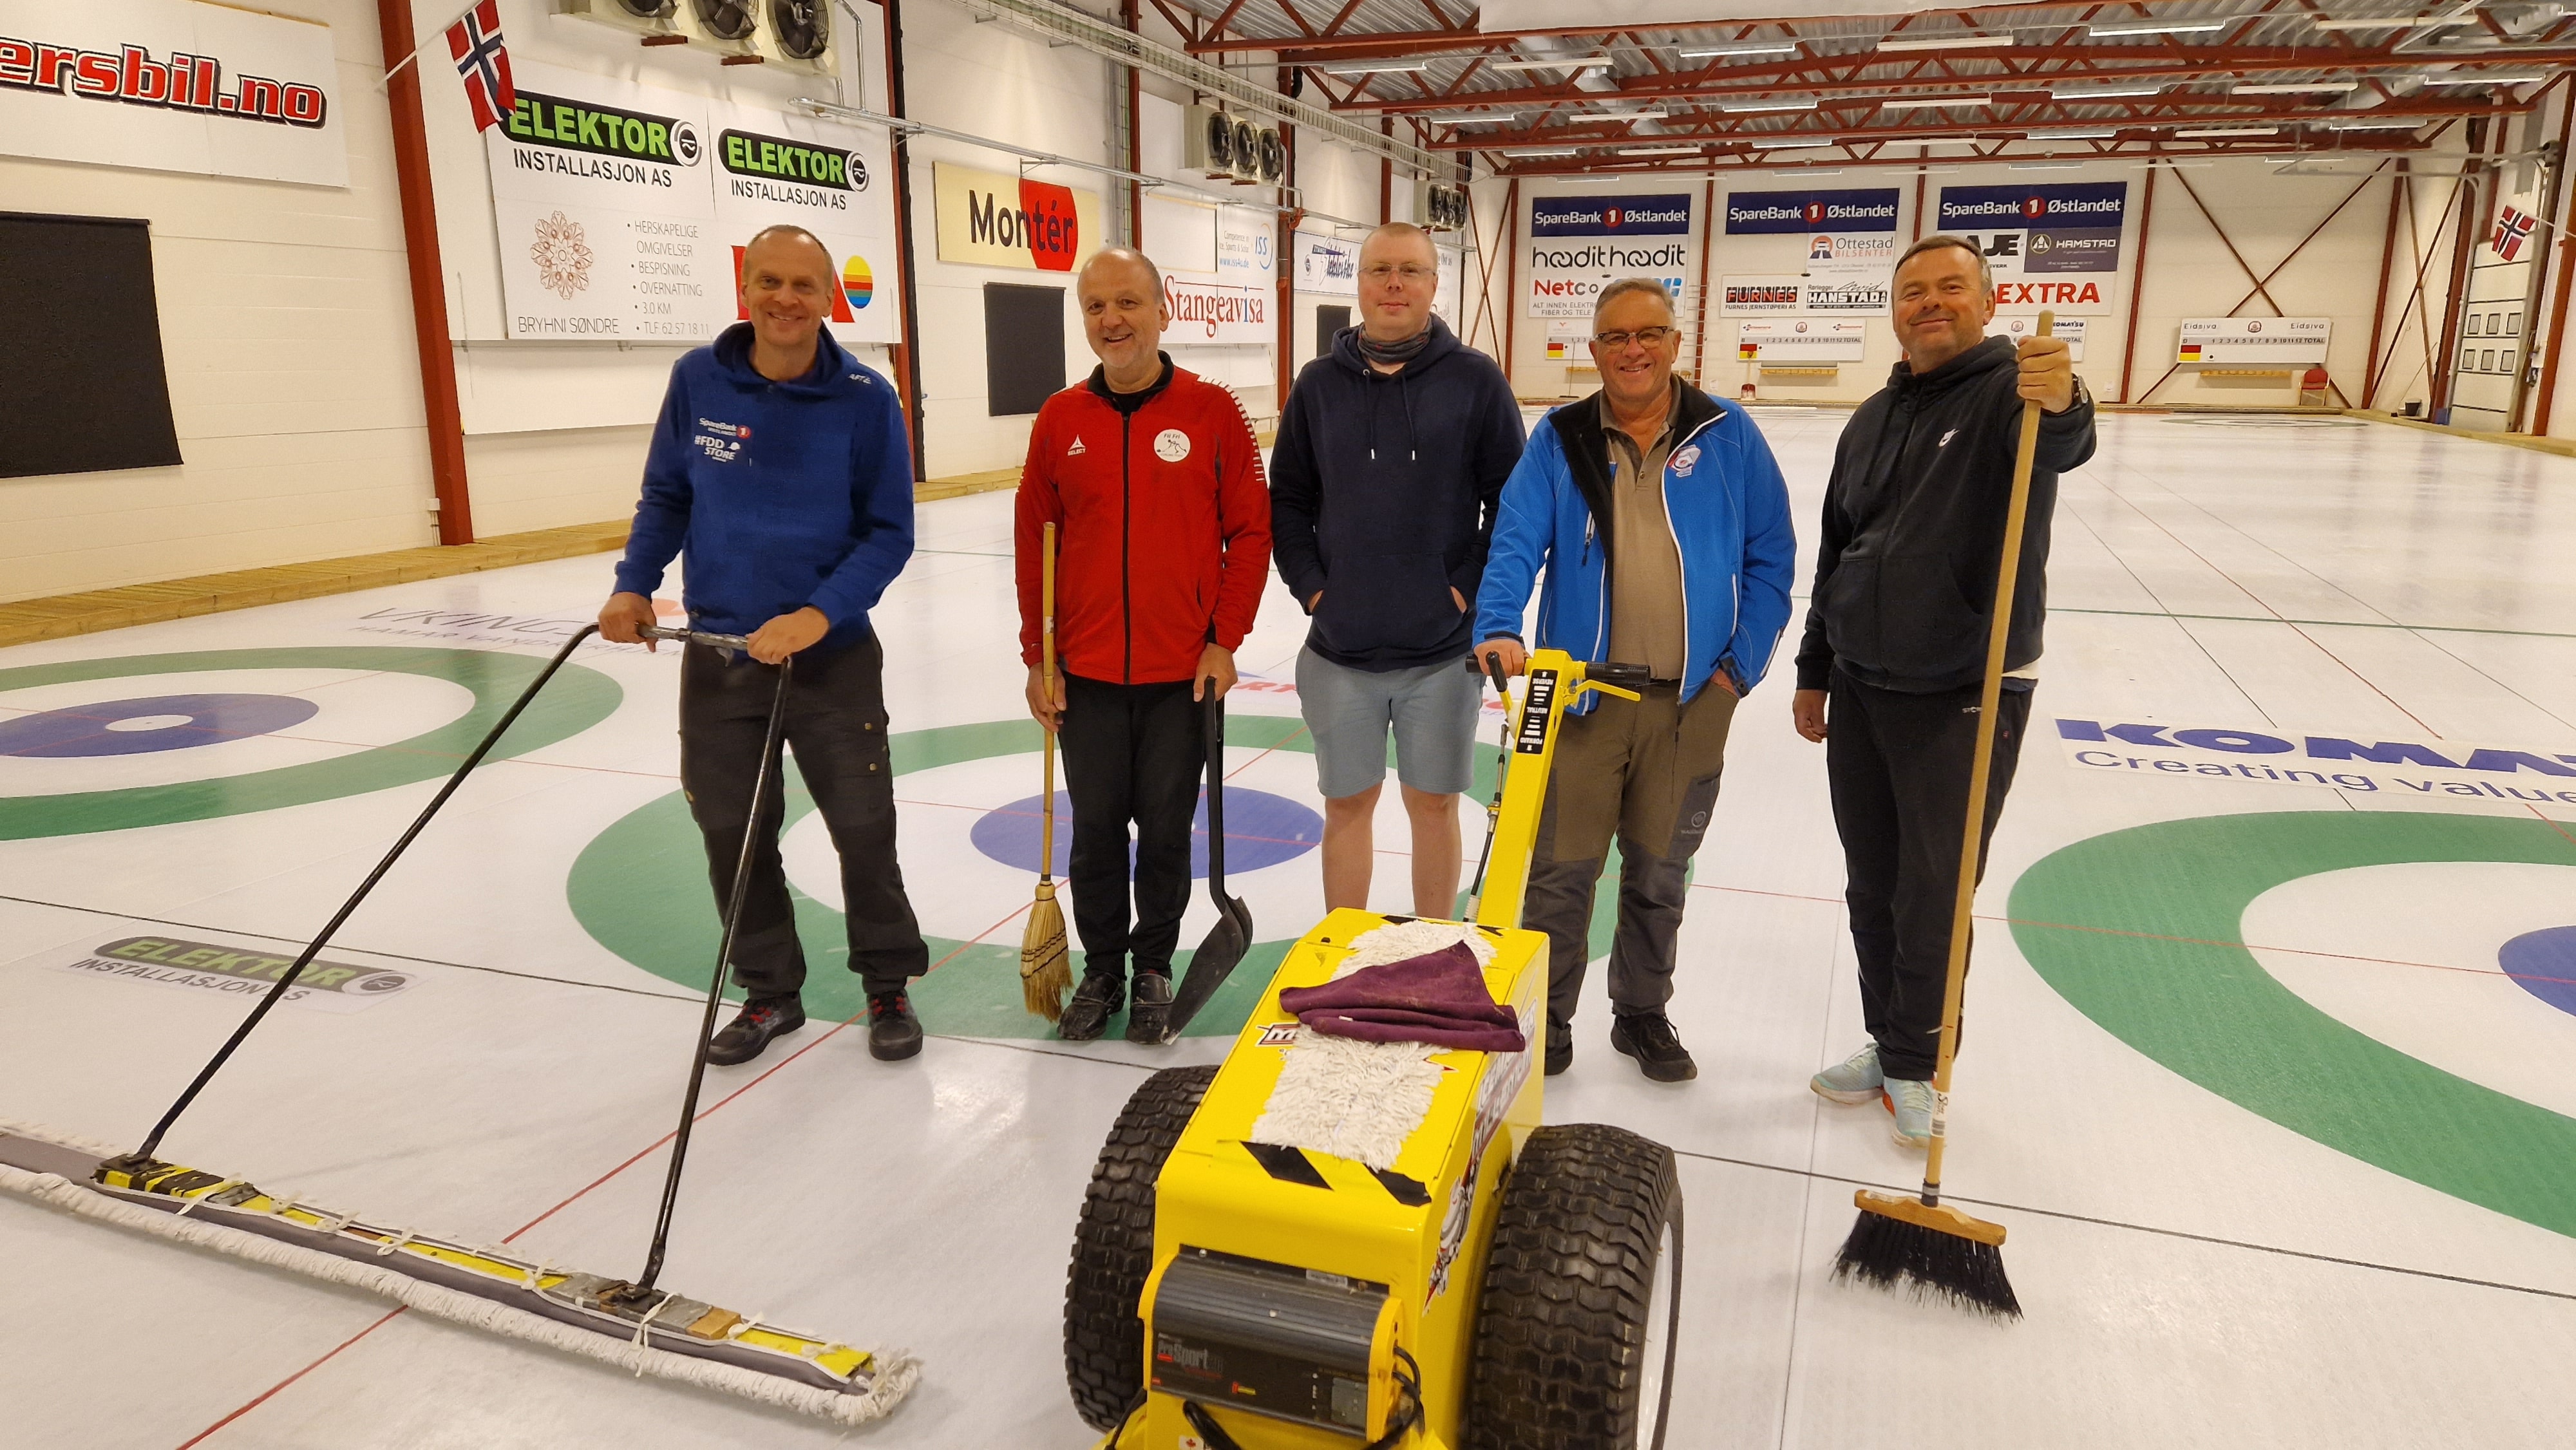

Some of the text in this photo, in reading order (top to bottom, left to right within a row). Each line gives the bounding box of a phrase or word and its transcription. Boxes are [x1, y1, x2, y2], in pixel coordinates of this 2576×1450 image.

[0, 37, 327, 129] ersbil.no
[509, 98, 670, 157] ELEKTOR
[513, 148, 672, 187] INSTALLASJON AS
[727, 136, 845, 184] ELEKTOR
[731, 179, 846, 210] INSTALLASJON AS
[1730, 204, 1895, 223] SpareBank 1 Østlandet
[1942, 198, 2121, 218] SpareBank 1 Østlandet
[969, 190, 1073, 253] Montér
[1535, 209, 1687, 226] SpareBank 1 Østlandet
[635, 221, 699, 238] HERSKAPELIGE
[636, 240, 692, 256] OMGIVELSER
[1836, 237, 1893, 249] Ottestad
[2056, 239, 2116, 249] HAMSTAD
[639, 261, 690, 276] BESPISNING
[640, 281, 702, 296] OVERNATTING
[1726, 287, 1797, 303] FURNES
[1808, 292, 1879, 303] HANSTAD
[1996, 282, 2101, 304] EXTRA
[658, 303, 671, 314] KM
[1164, 275, 1264, 337] Stangeavisa
[518, 317, 620, 334] BRYHNI SØNDRE
[644, 321, 659, 334] TLF
[662, 322, 672, 334] 62
[676, 323, 685, 334] 57
[699, 418, 737, 431] SpareBank
[704, 447, 735, 460] STORE
[359, 608, 589, 636] VIKING
[2076, 751, 2576, 803] Creating value
[108, 938, 357, 986] ELEKTOR
[70, 958, 269, 995] INSTALLASJON
